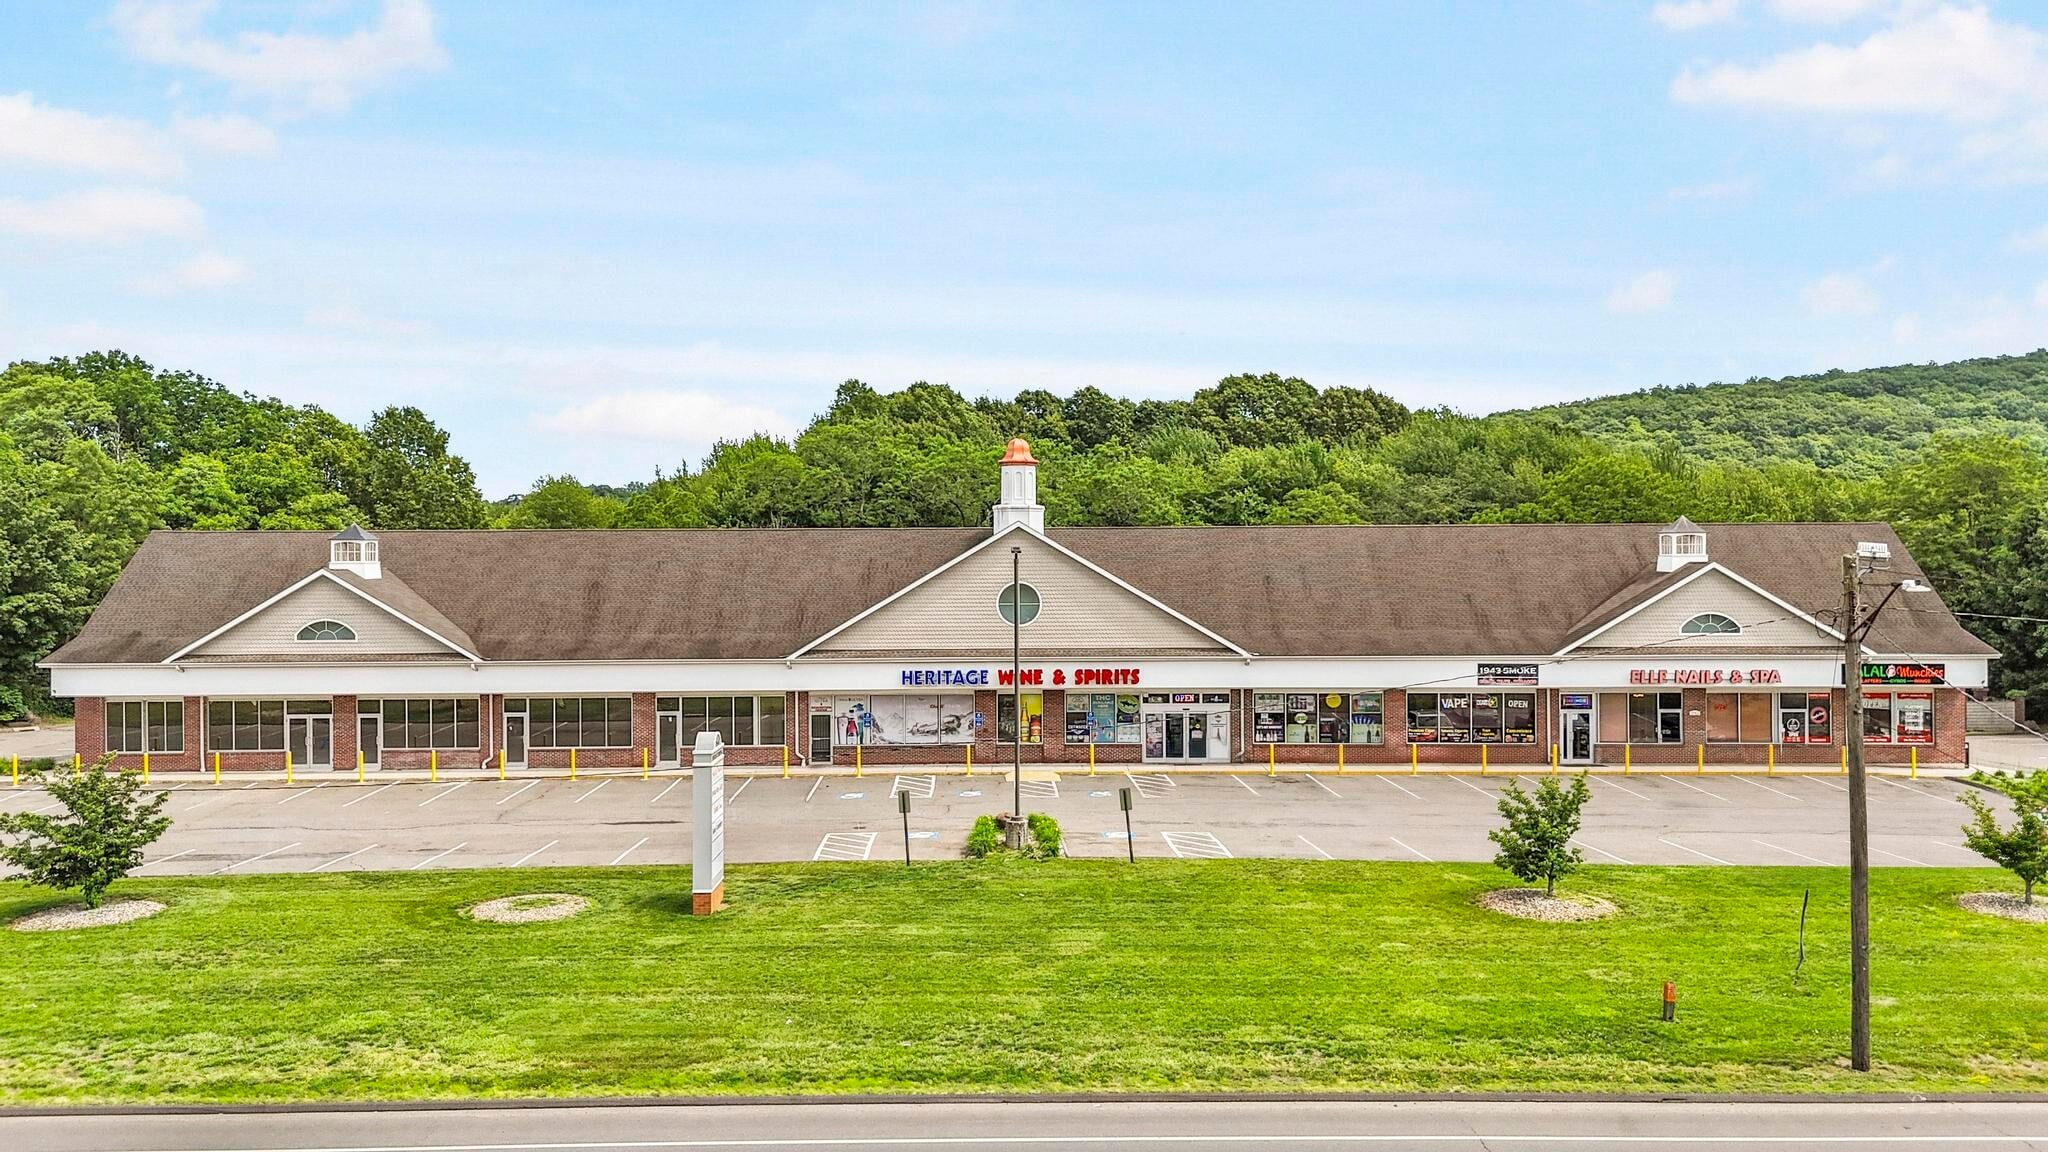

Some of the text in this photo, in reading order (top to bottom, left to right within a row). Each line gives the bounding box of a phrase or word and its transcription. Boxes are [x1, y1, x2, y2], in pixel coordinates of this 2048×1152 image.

[1479, 667, 1537, 675] 1943 SMOKE
[1859, 665, 1886, 677] LAL
[901, 669, 1140, 686] HERITAGE WNE & SPIRITS
[1631, 670, 1781, 684] ELLE NAILS & SPA
[1175, 694, 1195, 702] OPEN
[1441, 698, 1468, 709] VAPE
[1508, 700, 1529, 708] OPEN
